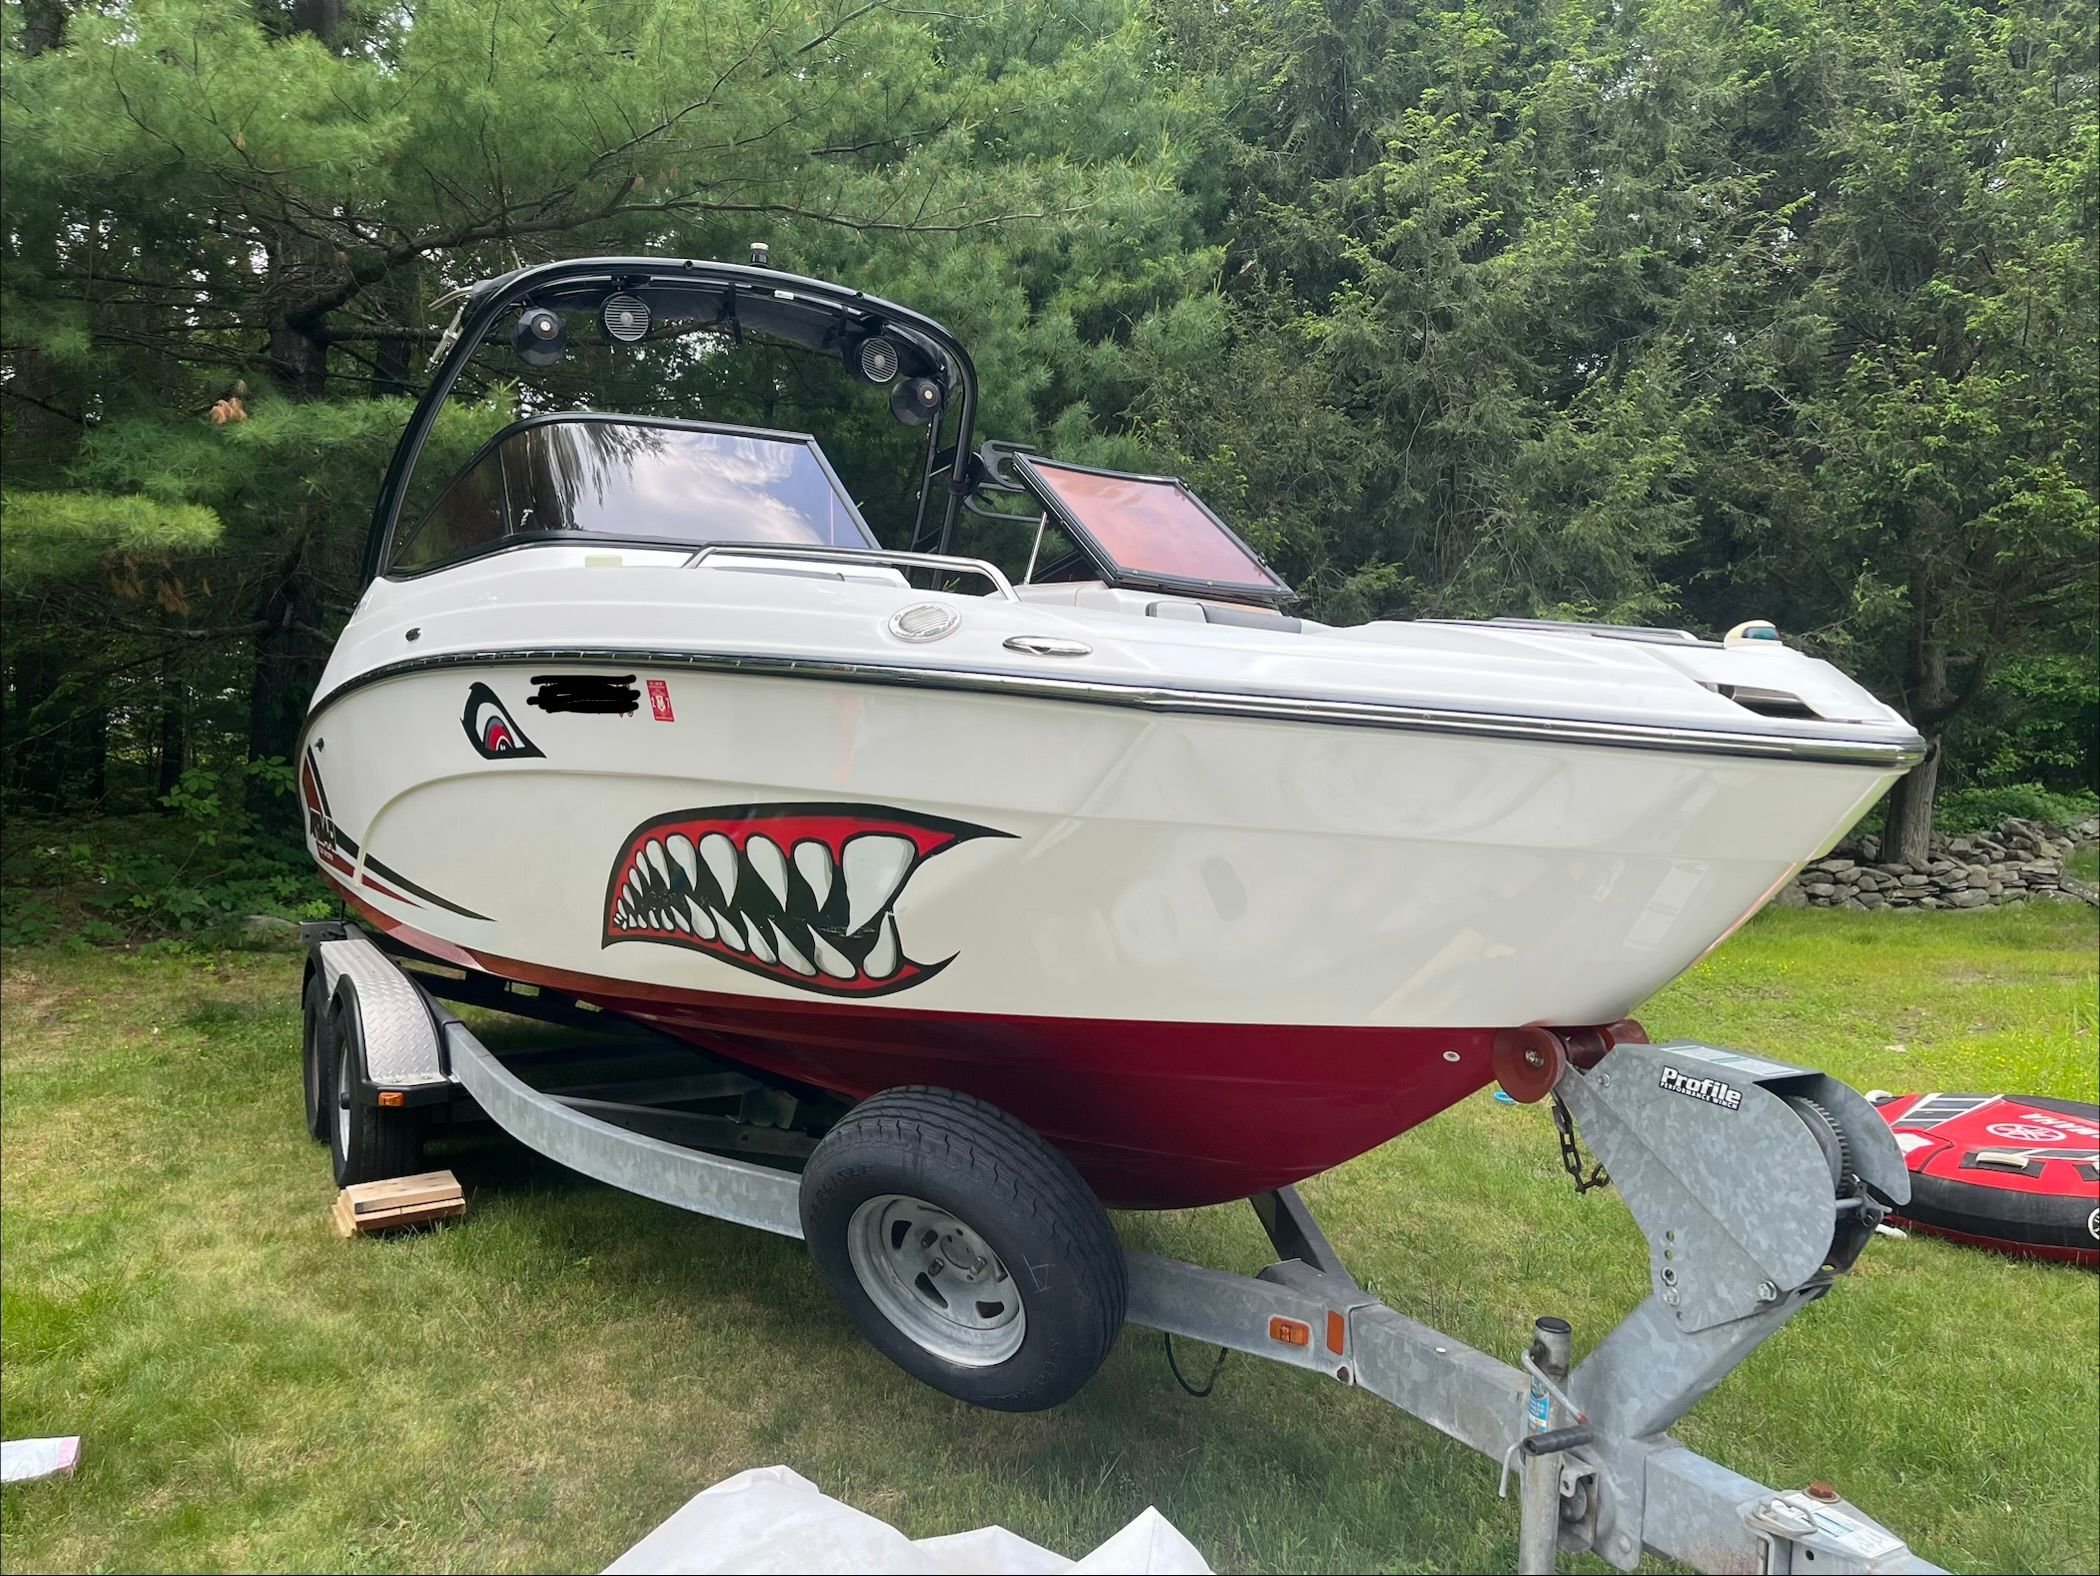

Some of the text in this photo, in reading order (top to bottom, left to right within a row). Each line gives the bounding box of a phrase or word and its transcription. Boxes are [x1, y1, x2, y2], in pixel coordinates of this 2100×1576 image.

[1660, 1082, 1738, 1109] PERFORMANCE WINCH
[1661, 1066, 1741, 1103] Profile
